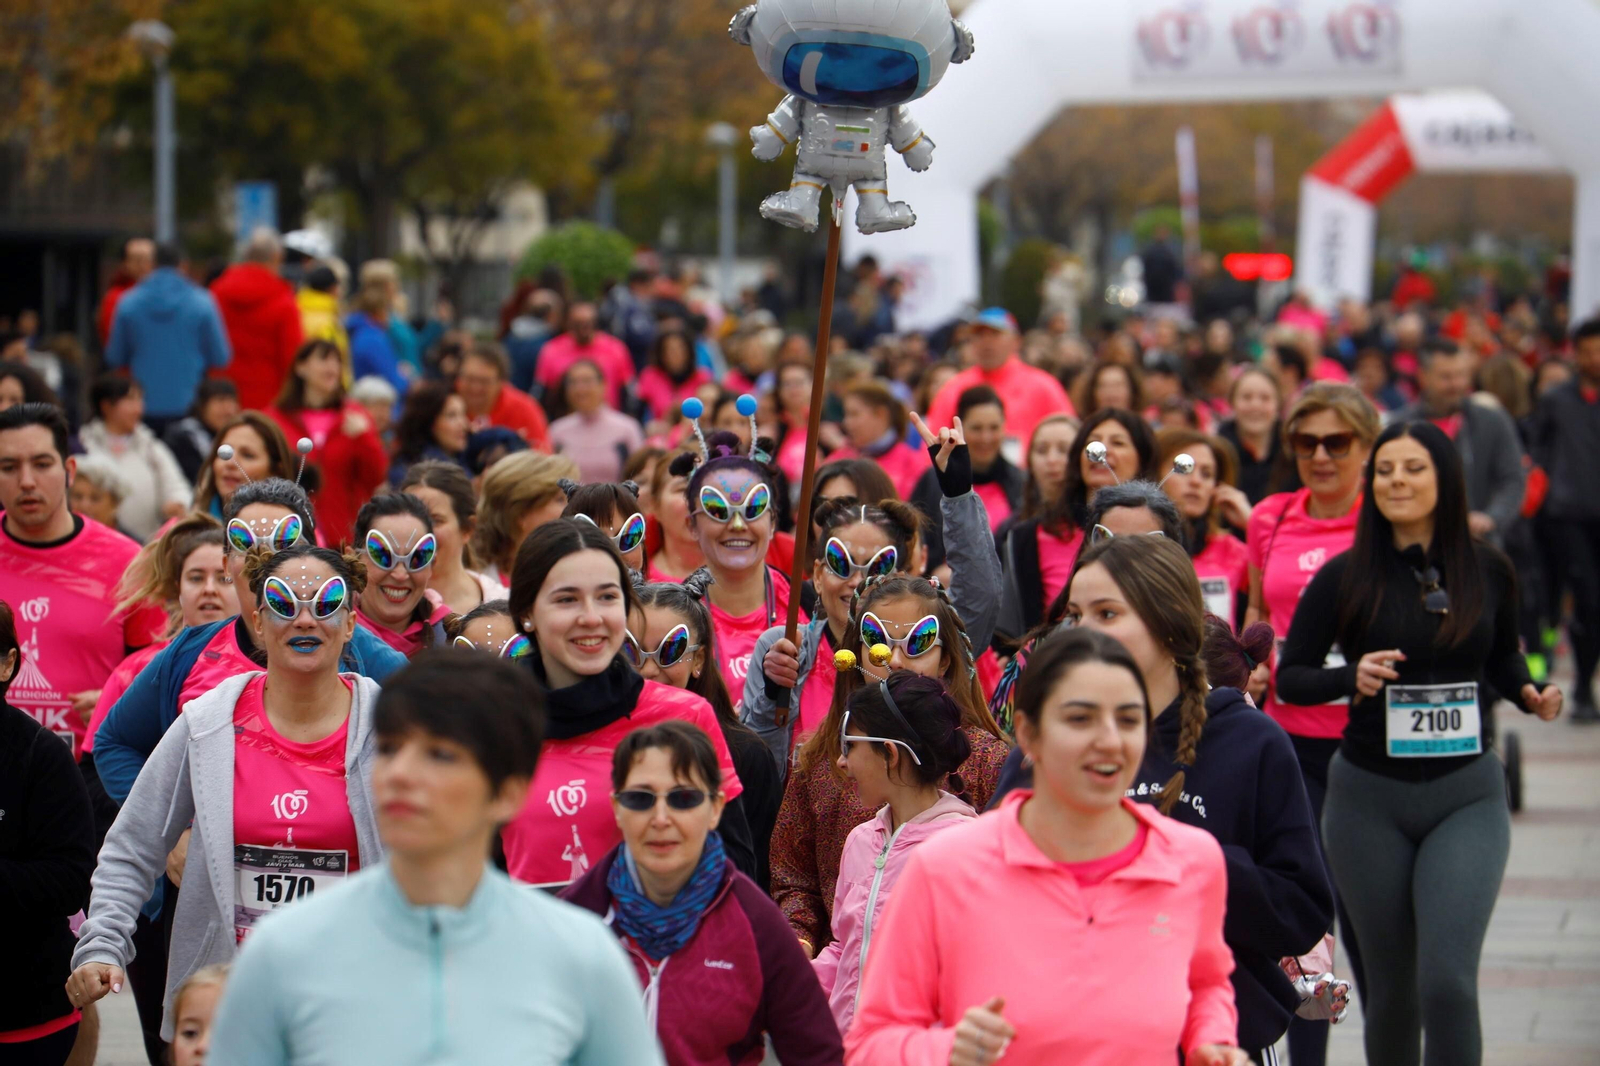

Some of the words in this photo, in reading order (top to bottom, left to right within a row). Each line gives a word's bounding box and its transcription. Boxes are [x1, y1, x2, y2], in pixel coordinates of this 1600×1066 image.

[15, 690, 61, 700] EDICIÓN
[1411, 708, 1461, 732] 2100
[270, 790, 309, 820] 100
[546, 779, 587, 817] 100
[1192, 795, 1207, 818] Co.
[253, 874, 315, 904] 1570
